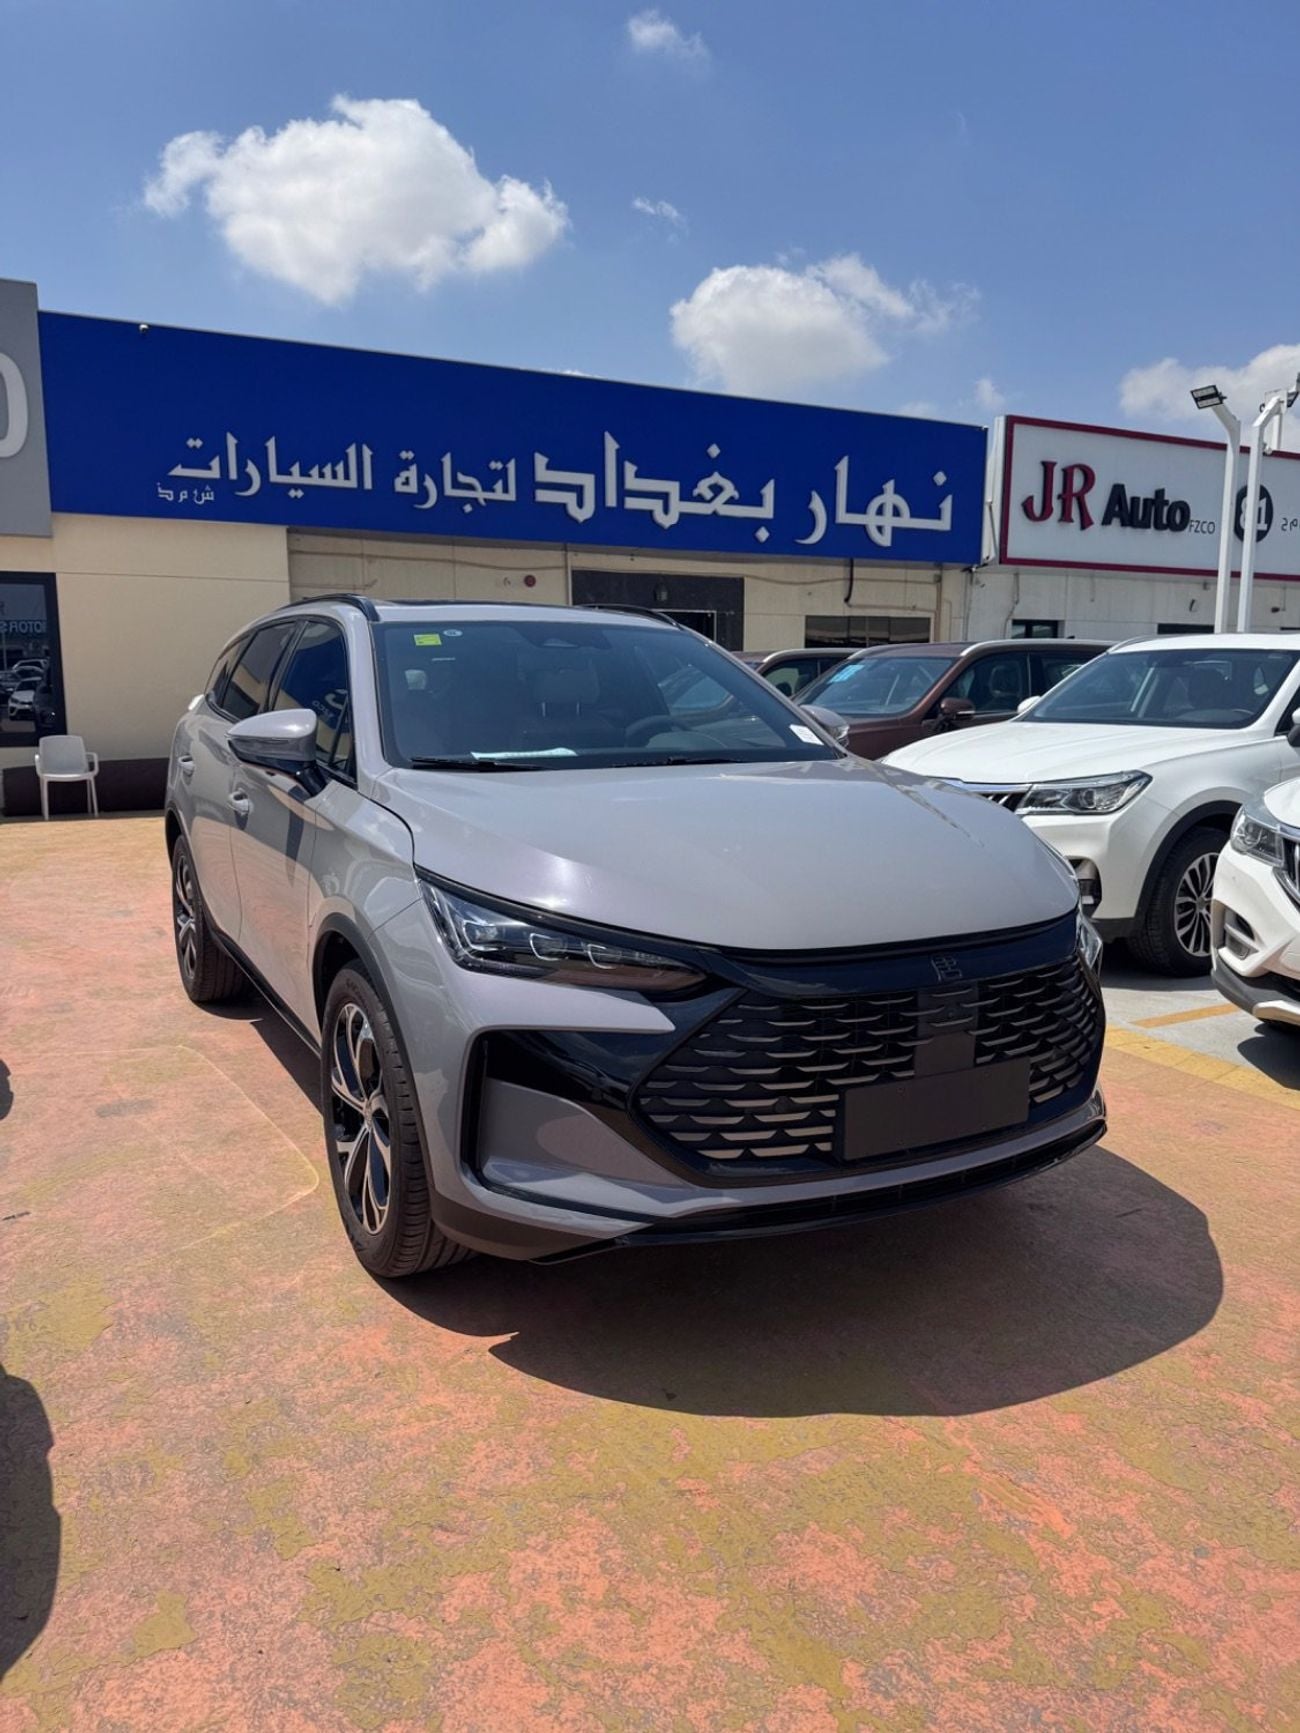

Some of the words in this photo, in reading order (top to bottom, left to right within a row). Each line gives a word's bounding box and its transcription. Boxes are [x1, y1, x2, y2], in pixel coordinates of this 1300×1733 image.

[167, 431, 373, 497] السيارات
[394, 450, 517, 513] لتجارة
[534, 431, 776, 543] بغداد
[795, 455, 953, 547] نهار
[1021, 460, 1095, 531] JR
[1101, 483, 1191, 532] Auto
[1189, 519, 1216, 535] FZCO
